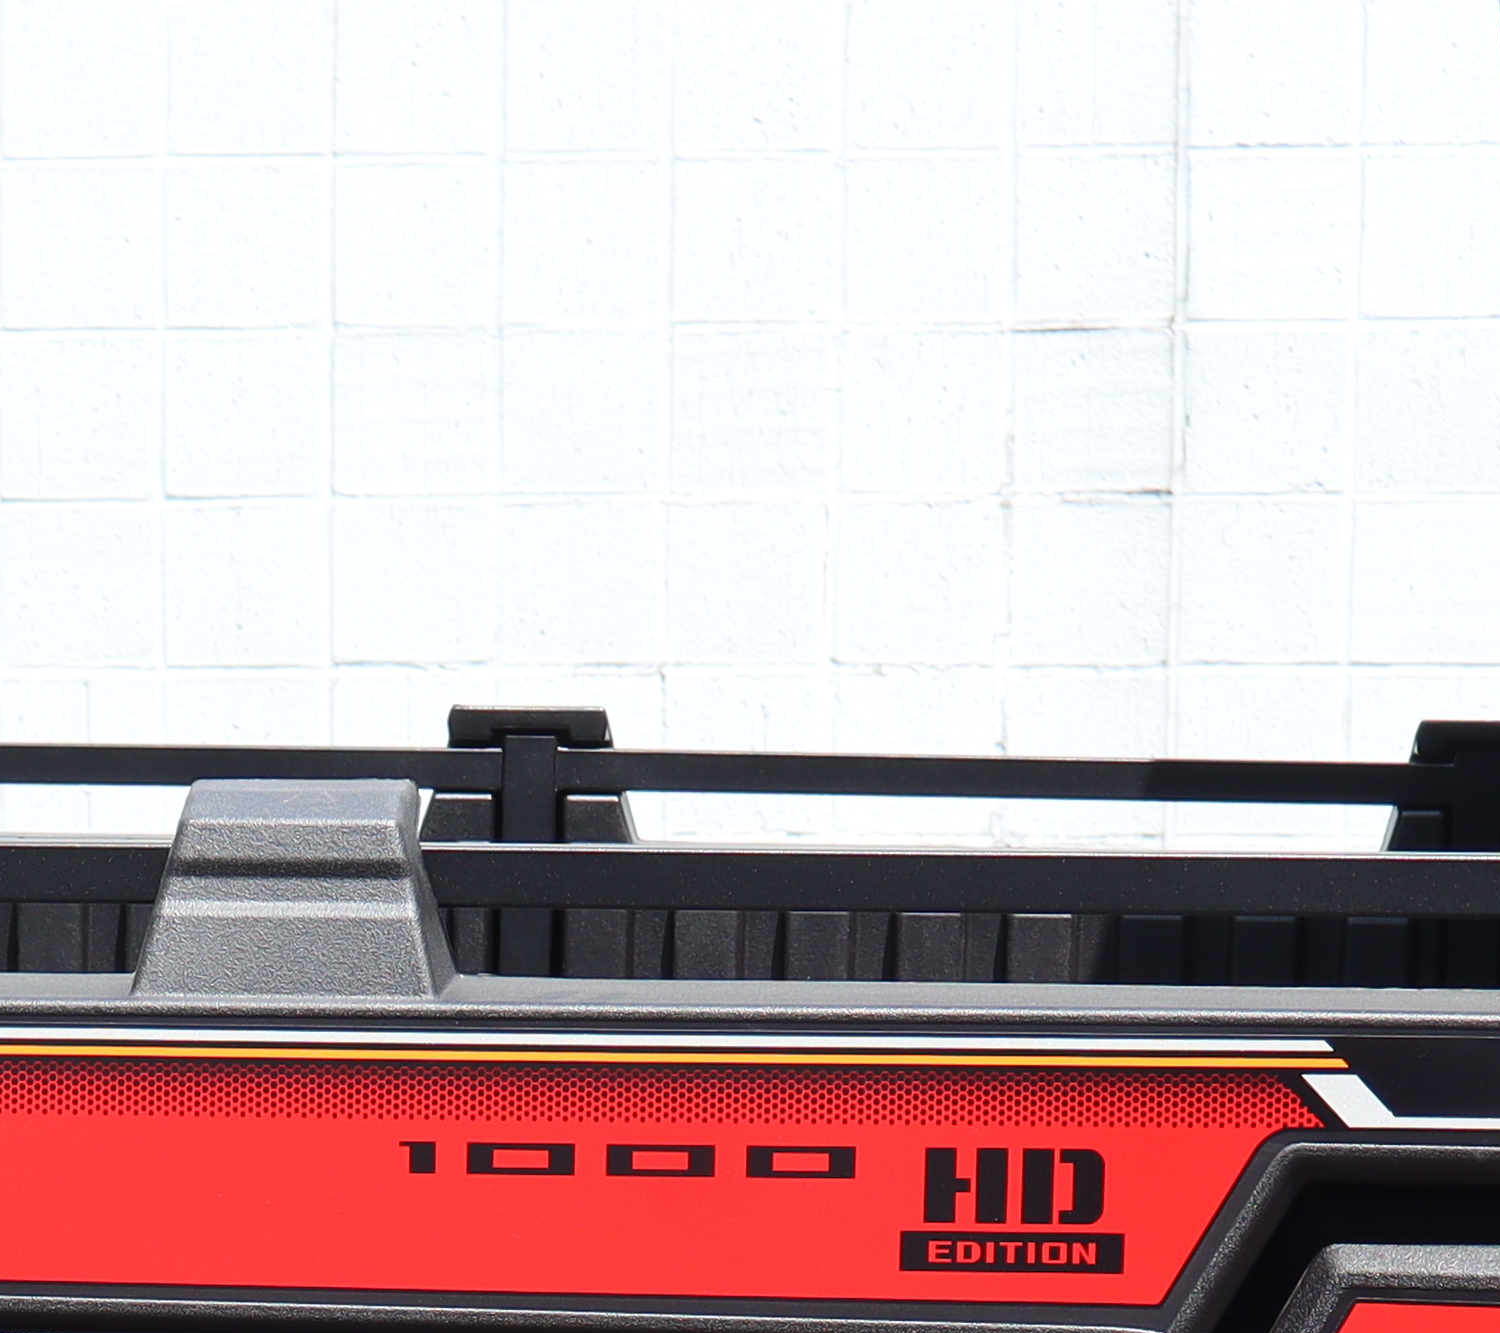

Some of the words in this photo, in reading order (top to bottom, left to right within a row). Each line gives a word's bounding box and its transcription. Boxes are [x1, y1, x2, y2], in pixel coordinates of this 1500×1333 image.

[399, 1141, 857, 1179] 1000
[923, 1147, 1106, 1225] HD
[927, 1239, 1098, 1266] EDITION
